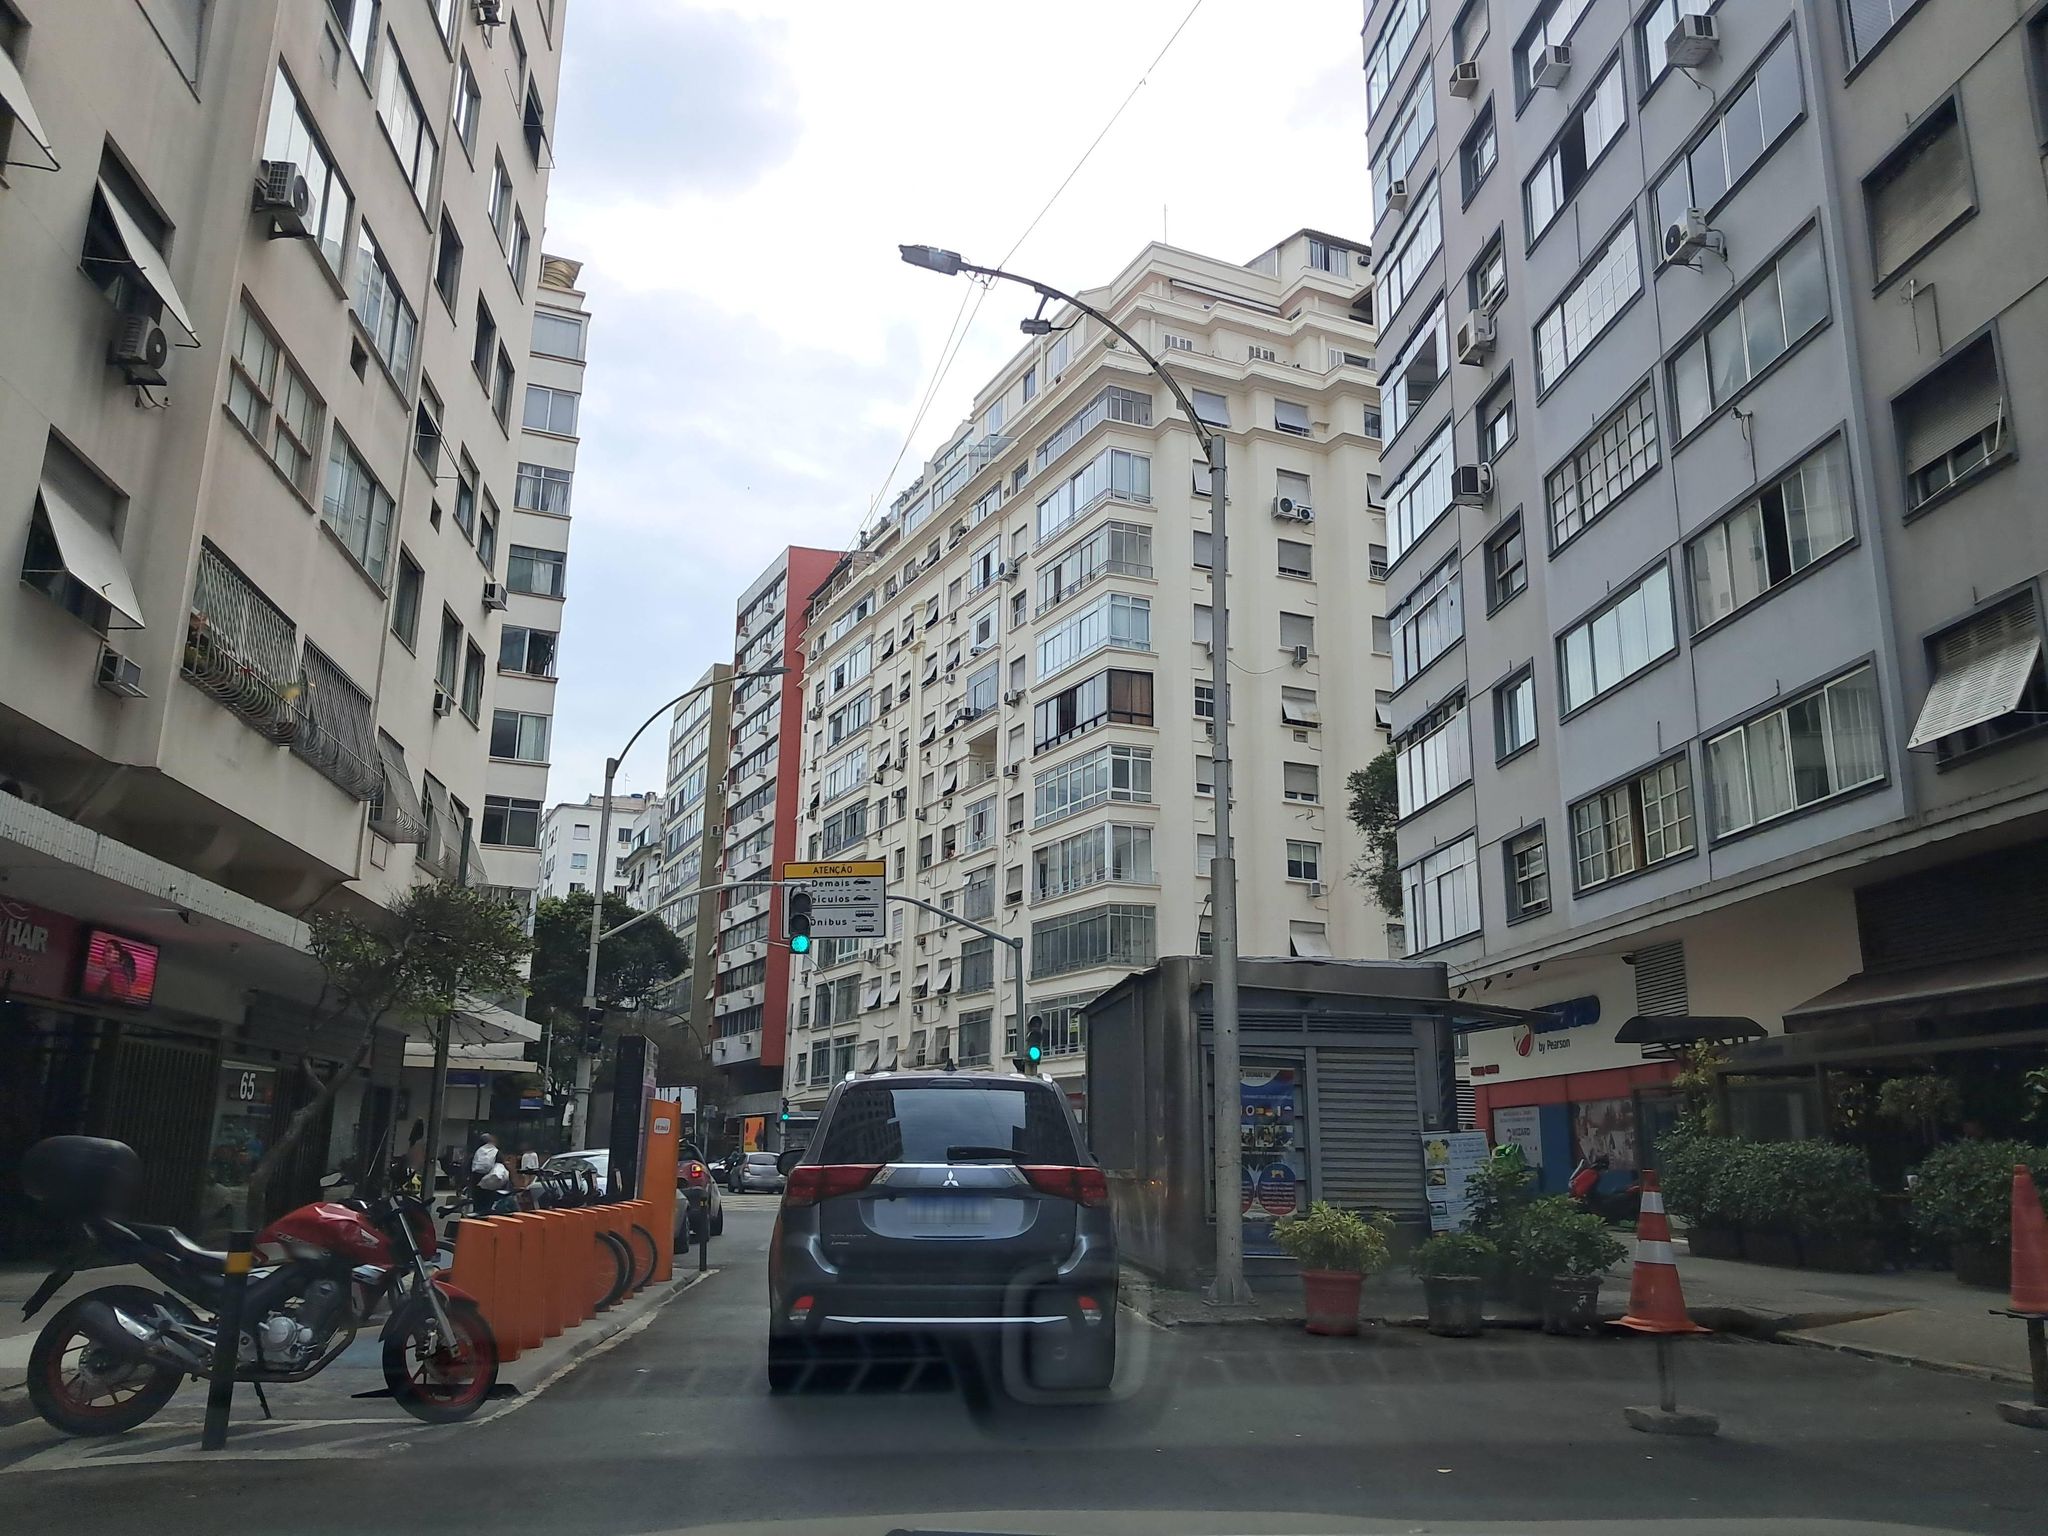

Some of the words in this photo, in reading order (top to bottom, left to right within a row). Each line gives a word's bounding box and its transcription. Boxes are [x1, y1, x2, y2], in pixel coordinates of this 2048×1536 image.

[813, 864, 853, 875] ATENÇÃO
[811, 895, 850, 903] eículos
[810, 916, 848, 926] Ônibus
[6, 919, 48, 953] HAIR
[1538, 1041, 1546, 1054] by
[1547, 1038, 1571, 1050] Pearson
[240, 1072, 256, 1100] 65
